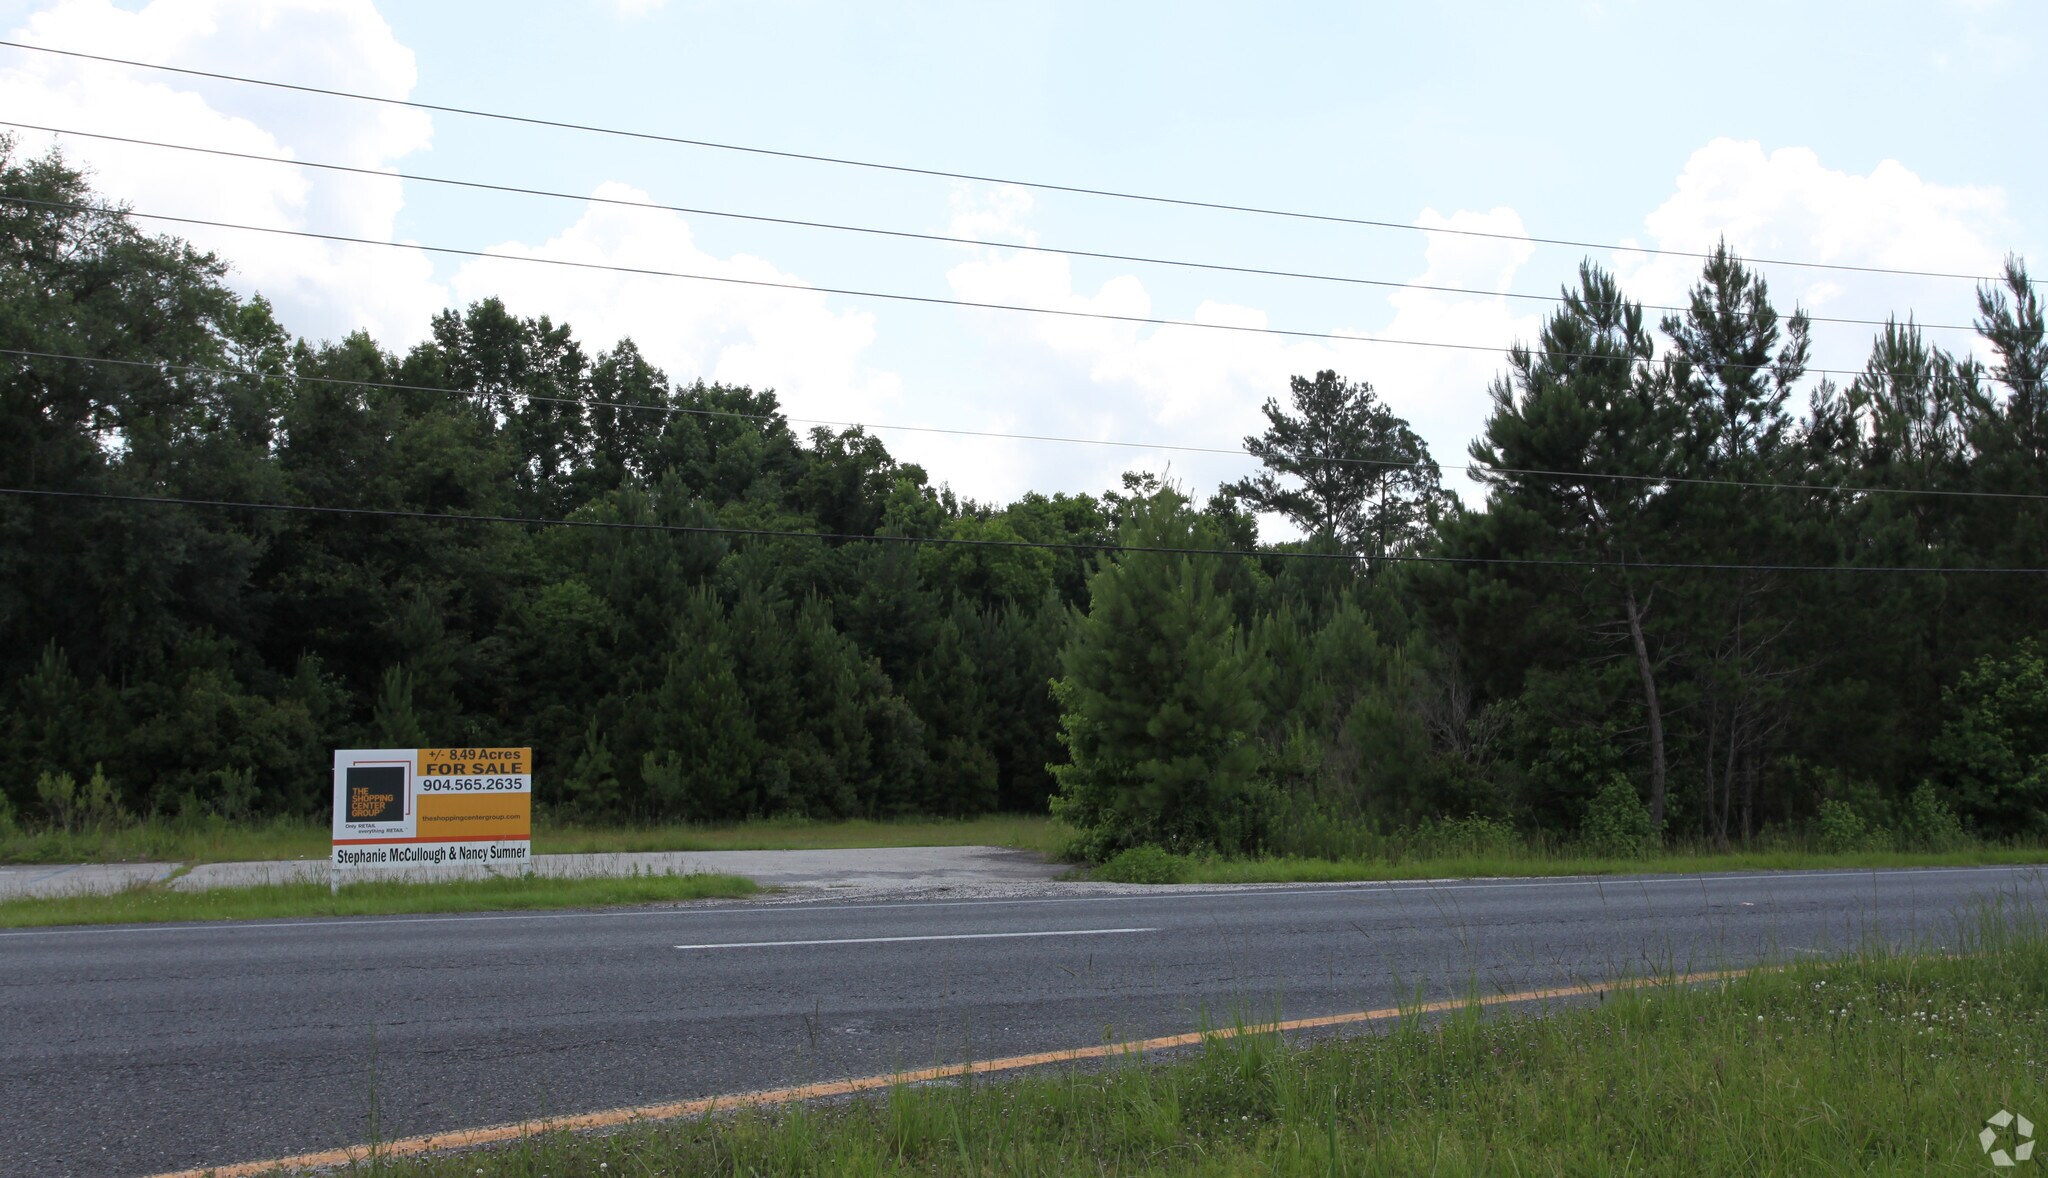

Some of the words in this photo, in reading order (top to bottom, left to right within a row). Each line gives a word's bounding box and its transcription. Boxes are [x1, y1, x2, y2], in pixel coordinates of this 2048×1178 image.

[449, 749, 476, 761] 8.49
[478, 749, 521, 760] Acres
[426, 763, 466, 776] FOR
[472, 762, 523, 775] SALE
[423, 778, 522, 791] 904.565.2635
[352, 787, 369, 795] THE
[352, 794, 394, 802] SHOPPING
[352, 801, 386, 809] CENTER
[422, 814, 521, 823] theshoppingcentergroup.com
[337, 848, 387, 866] Stephanie
[389, 847, 447, 864] McCullough
[449, 846, 457, 860] &
[459, 845, 489, 863] Nancy
[490, 845, 526, 859] Sumner
